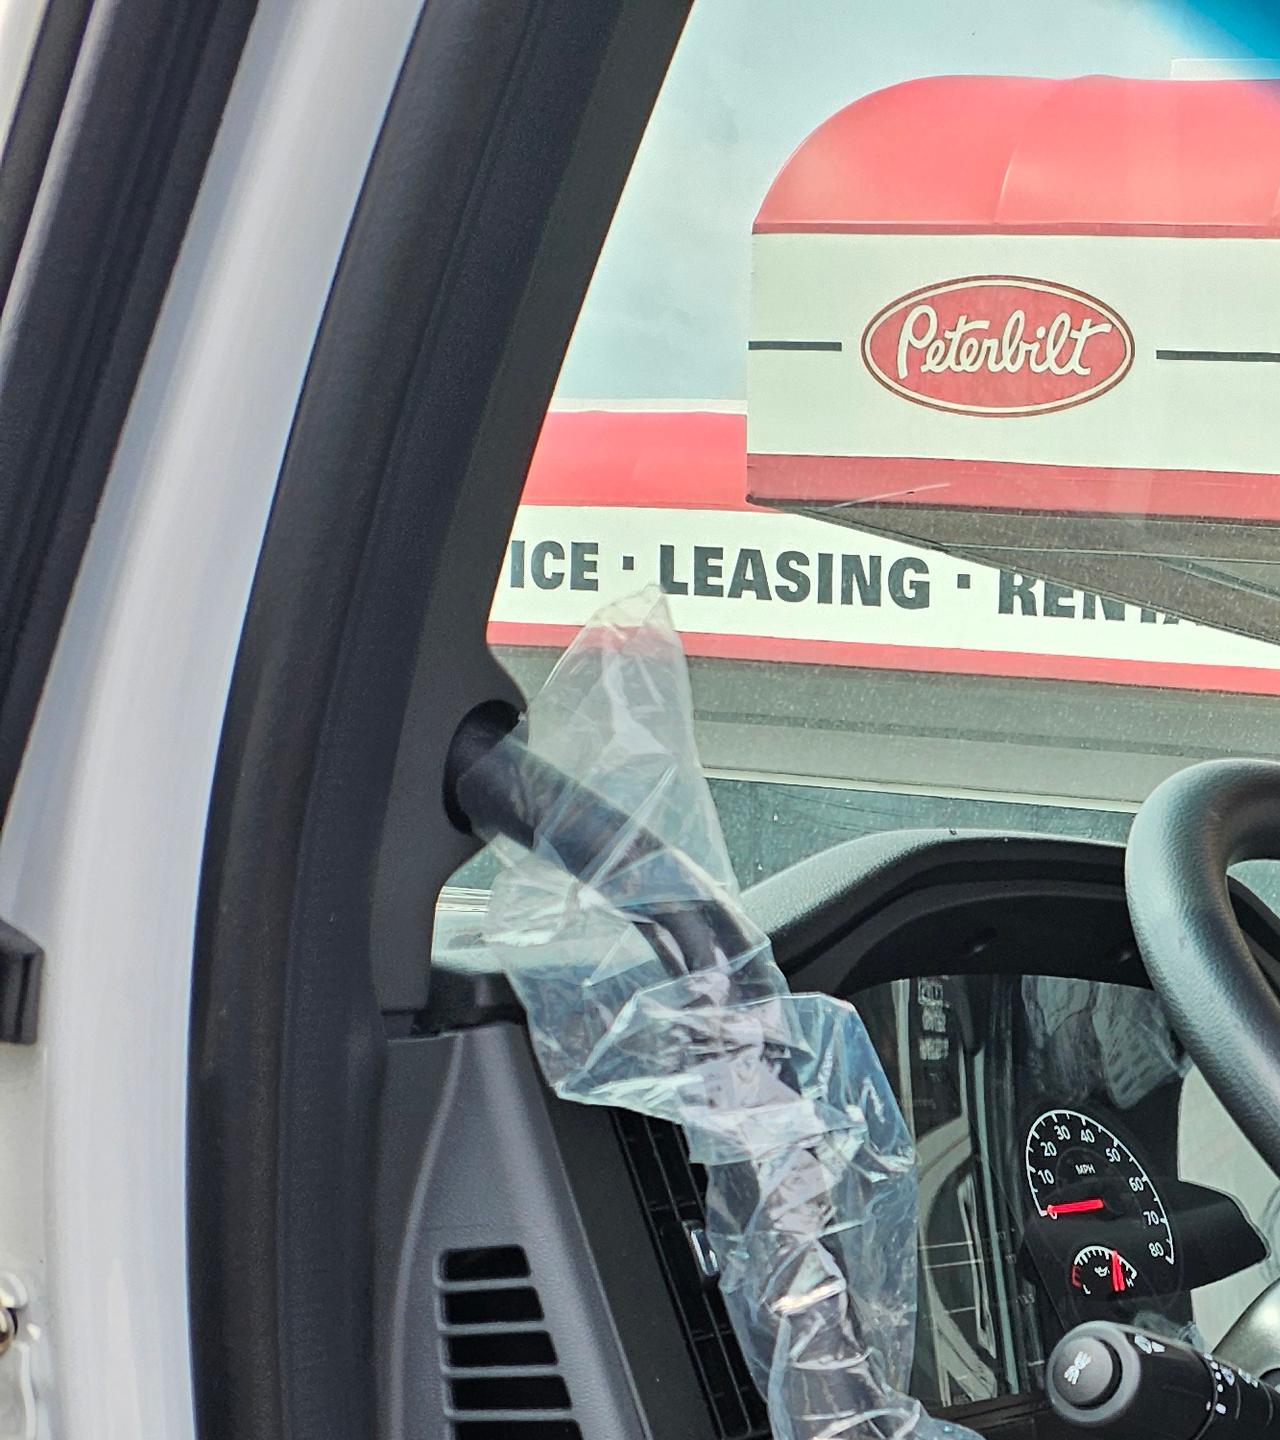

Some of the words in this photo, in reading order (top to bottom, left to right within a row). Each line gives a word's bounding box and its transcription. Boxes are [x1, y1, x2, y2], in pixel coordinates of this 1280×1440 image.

[897, 304, 1113, 379] Peterbilt
[510, 540, 599, 591] ICE
[659, 544, 931, 610] LEASING
[1053, 1125, 1071, 1141] 30
[1080, 1128, 1095, 1144] 40
[1040, 1141, 1057, 1157] 20
[1105, 1147, 1121, 1163] 50
[1038, 1169, 1055, 1185] 10
[1075, 1164, 1096, 1175] MPH
[1128, 1176, 1144, 1192] 60
[1143, 1210, 1160, 1226] 70
[1148, 1242, 1164, 1258] 80
